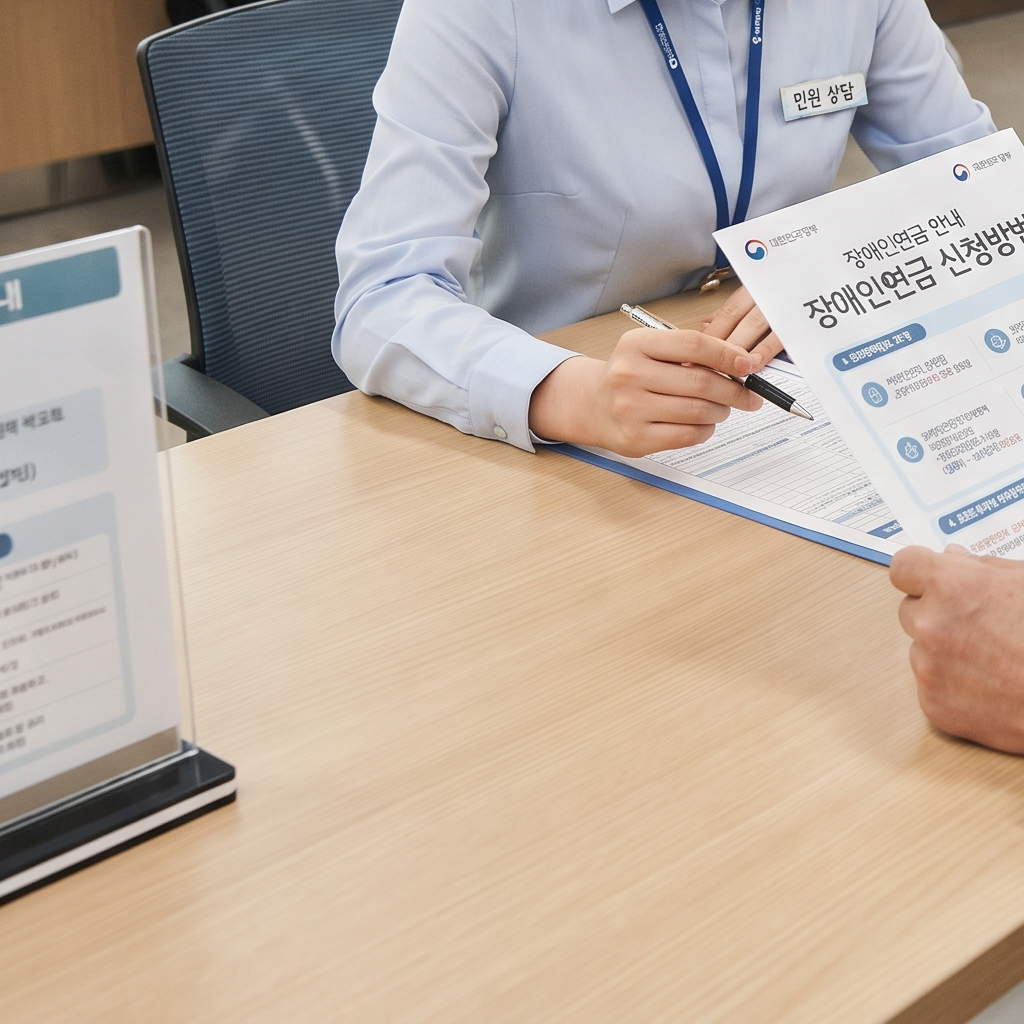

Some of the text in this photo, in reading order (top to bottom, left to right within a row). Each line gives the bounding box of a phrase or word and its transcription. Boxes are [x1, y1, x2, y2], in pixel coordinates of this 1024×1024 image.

[793, 81, 855, 111] 민원 상담
[842, 208, 966, 269] 장애인연금 안내
[802, 255, 937, 329] 장애인연금
